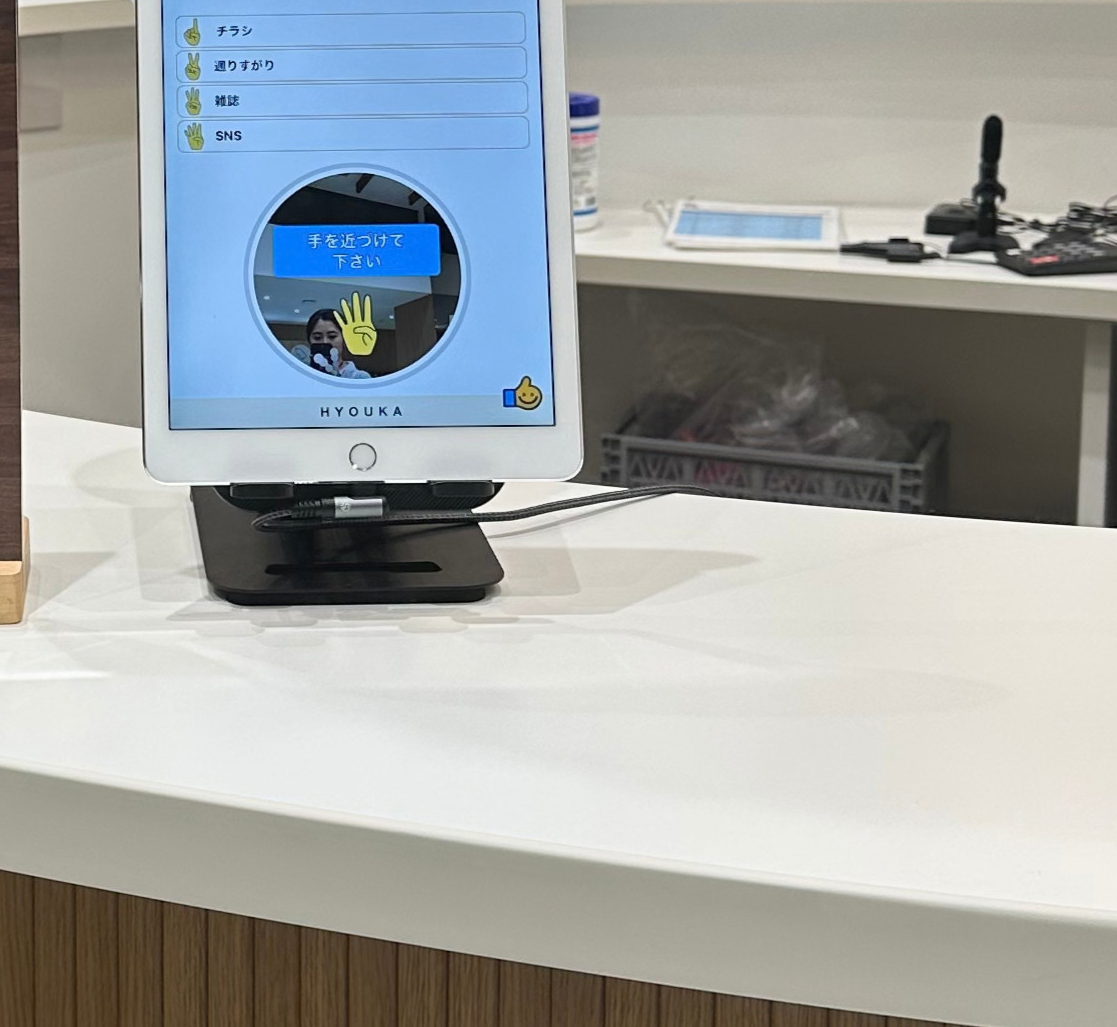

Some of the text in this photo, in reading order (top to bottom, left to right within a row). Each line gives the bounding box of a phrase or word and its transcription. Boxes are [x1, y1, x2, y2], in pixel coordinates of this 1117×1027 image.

[216, 25, 253, 37] チラシ
[215, 130, 242, 142] SNS
[332, 254, 381, 269] 下さい
[320, 406, 403, 418] HYOUKA
